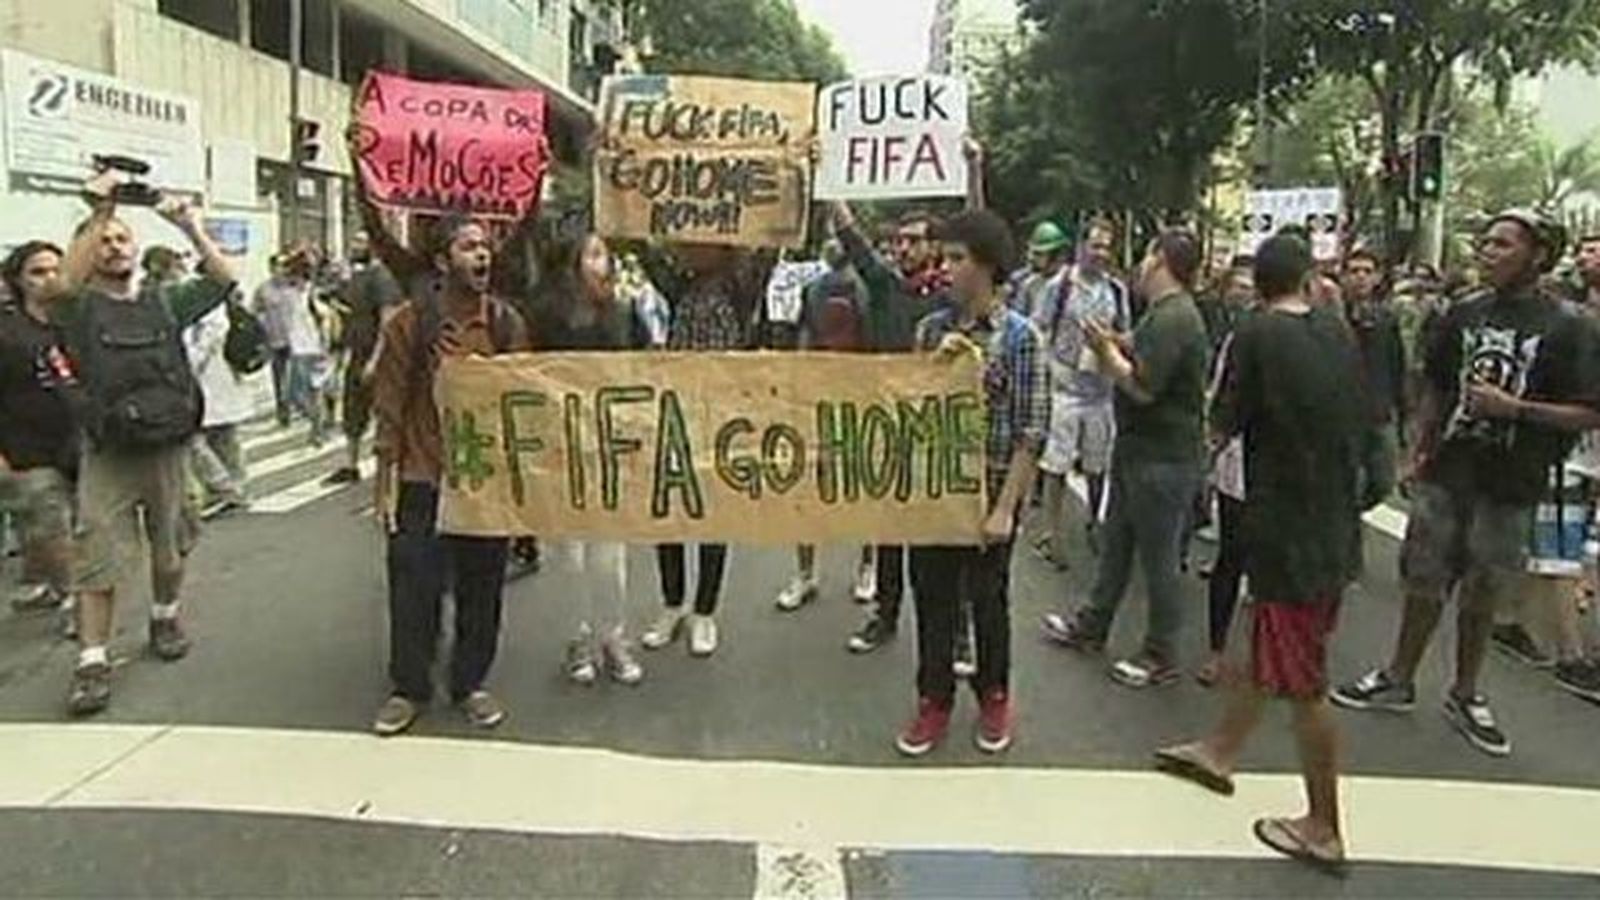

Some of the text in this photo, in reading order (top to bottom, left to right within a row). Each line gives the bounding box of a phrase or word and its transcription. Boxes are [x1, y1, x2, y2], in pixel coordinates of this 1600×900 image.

[359, 76, 386, 113] A
[401, 98, 489, 122] COPA
[620, 100, 714, 139] FUCK
[829, 79, 949, 132] FUCK
[846, 133, 947, 185] FIFA
[714, 417, 804, 500] GO
[815, 392, 982, 503] HOME
